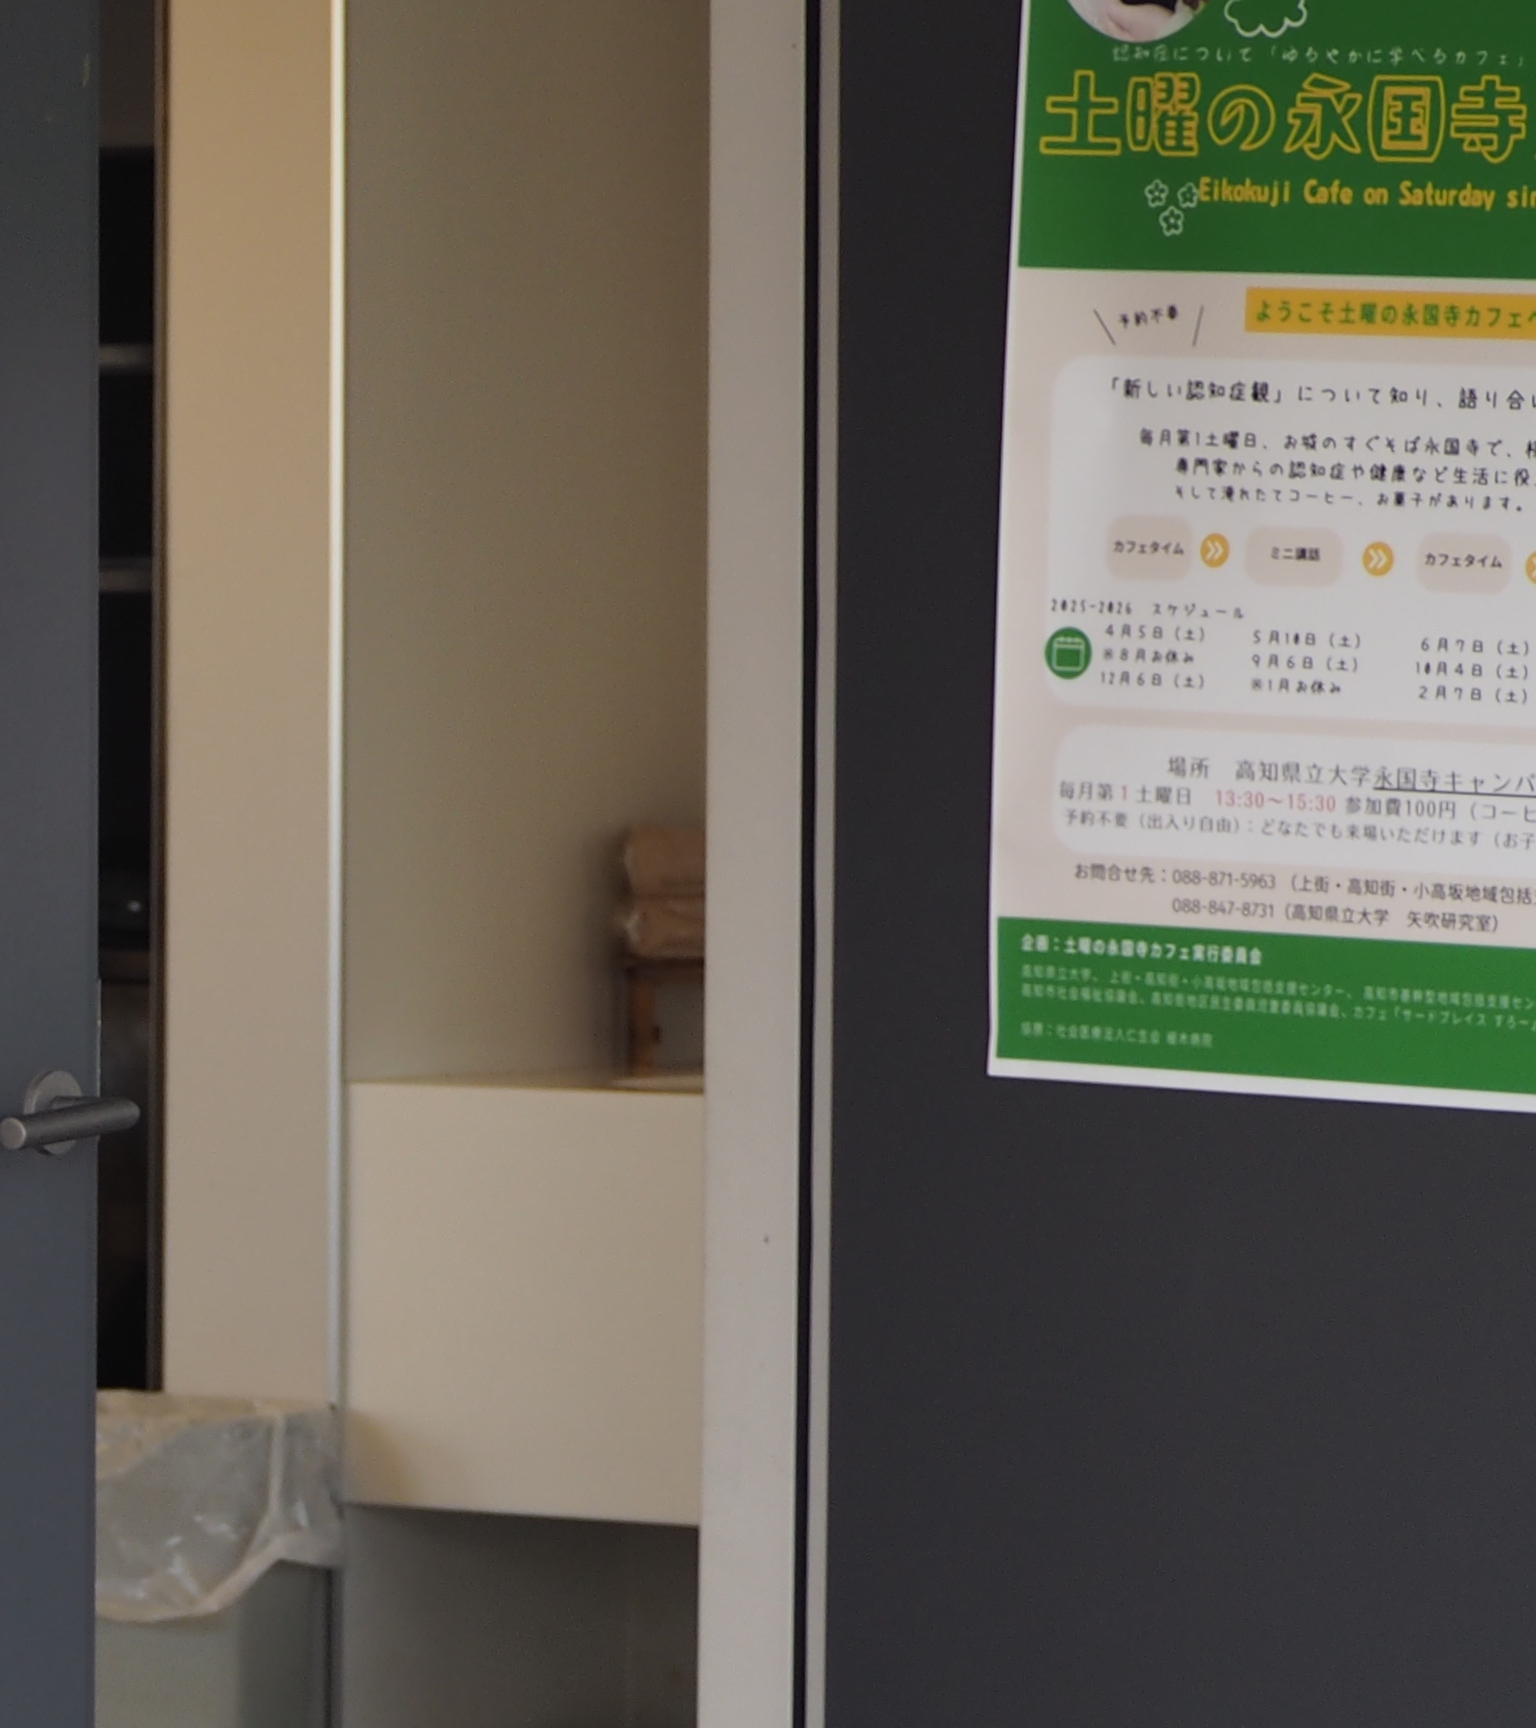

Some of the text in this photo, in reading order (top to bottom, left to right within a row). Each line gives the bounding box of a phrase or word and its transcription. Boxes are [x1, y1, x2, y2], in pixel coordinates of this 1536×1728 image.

[1039, 68, 1528, 164] 土曜の永国寺
[1199, 176, 1291, 207] Eikokuji
[1303, 179, 1354, 205] Cafe
[1363, 186, 1389, 206] on
[1399, 179, 1496, 211] Saturday
[1112, 538, 1185, 557] カフェタイム
[1425, 552, 1503, 569] カフェタイム
[1167, 755, 1210, 779] 場所
